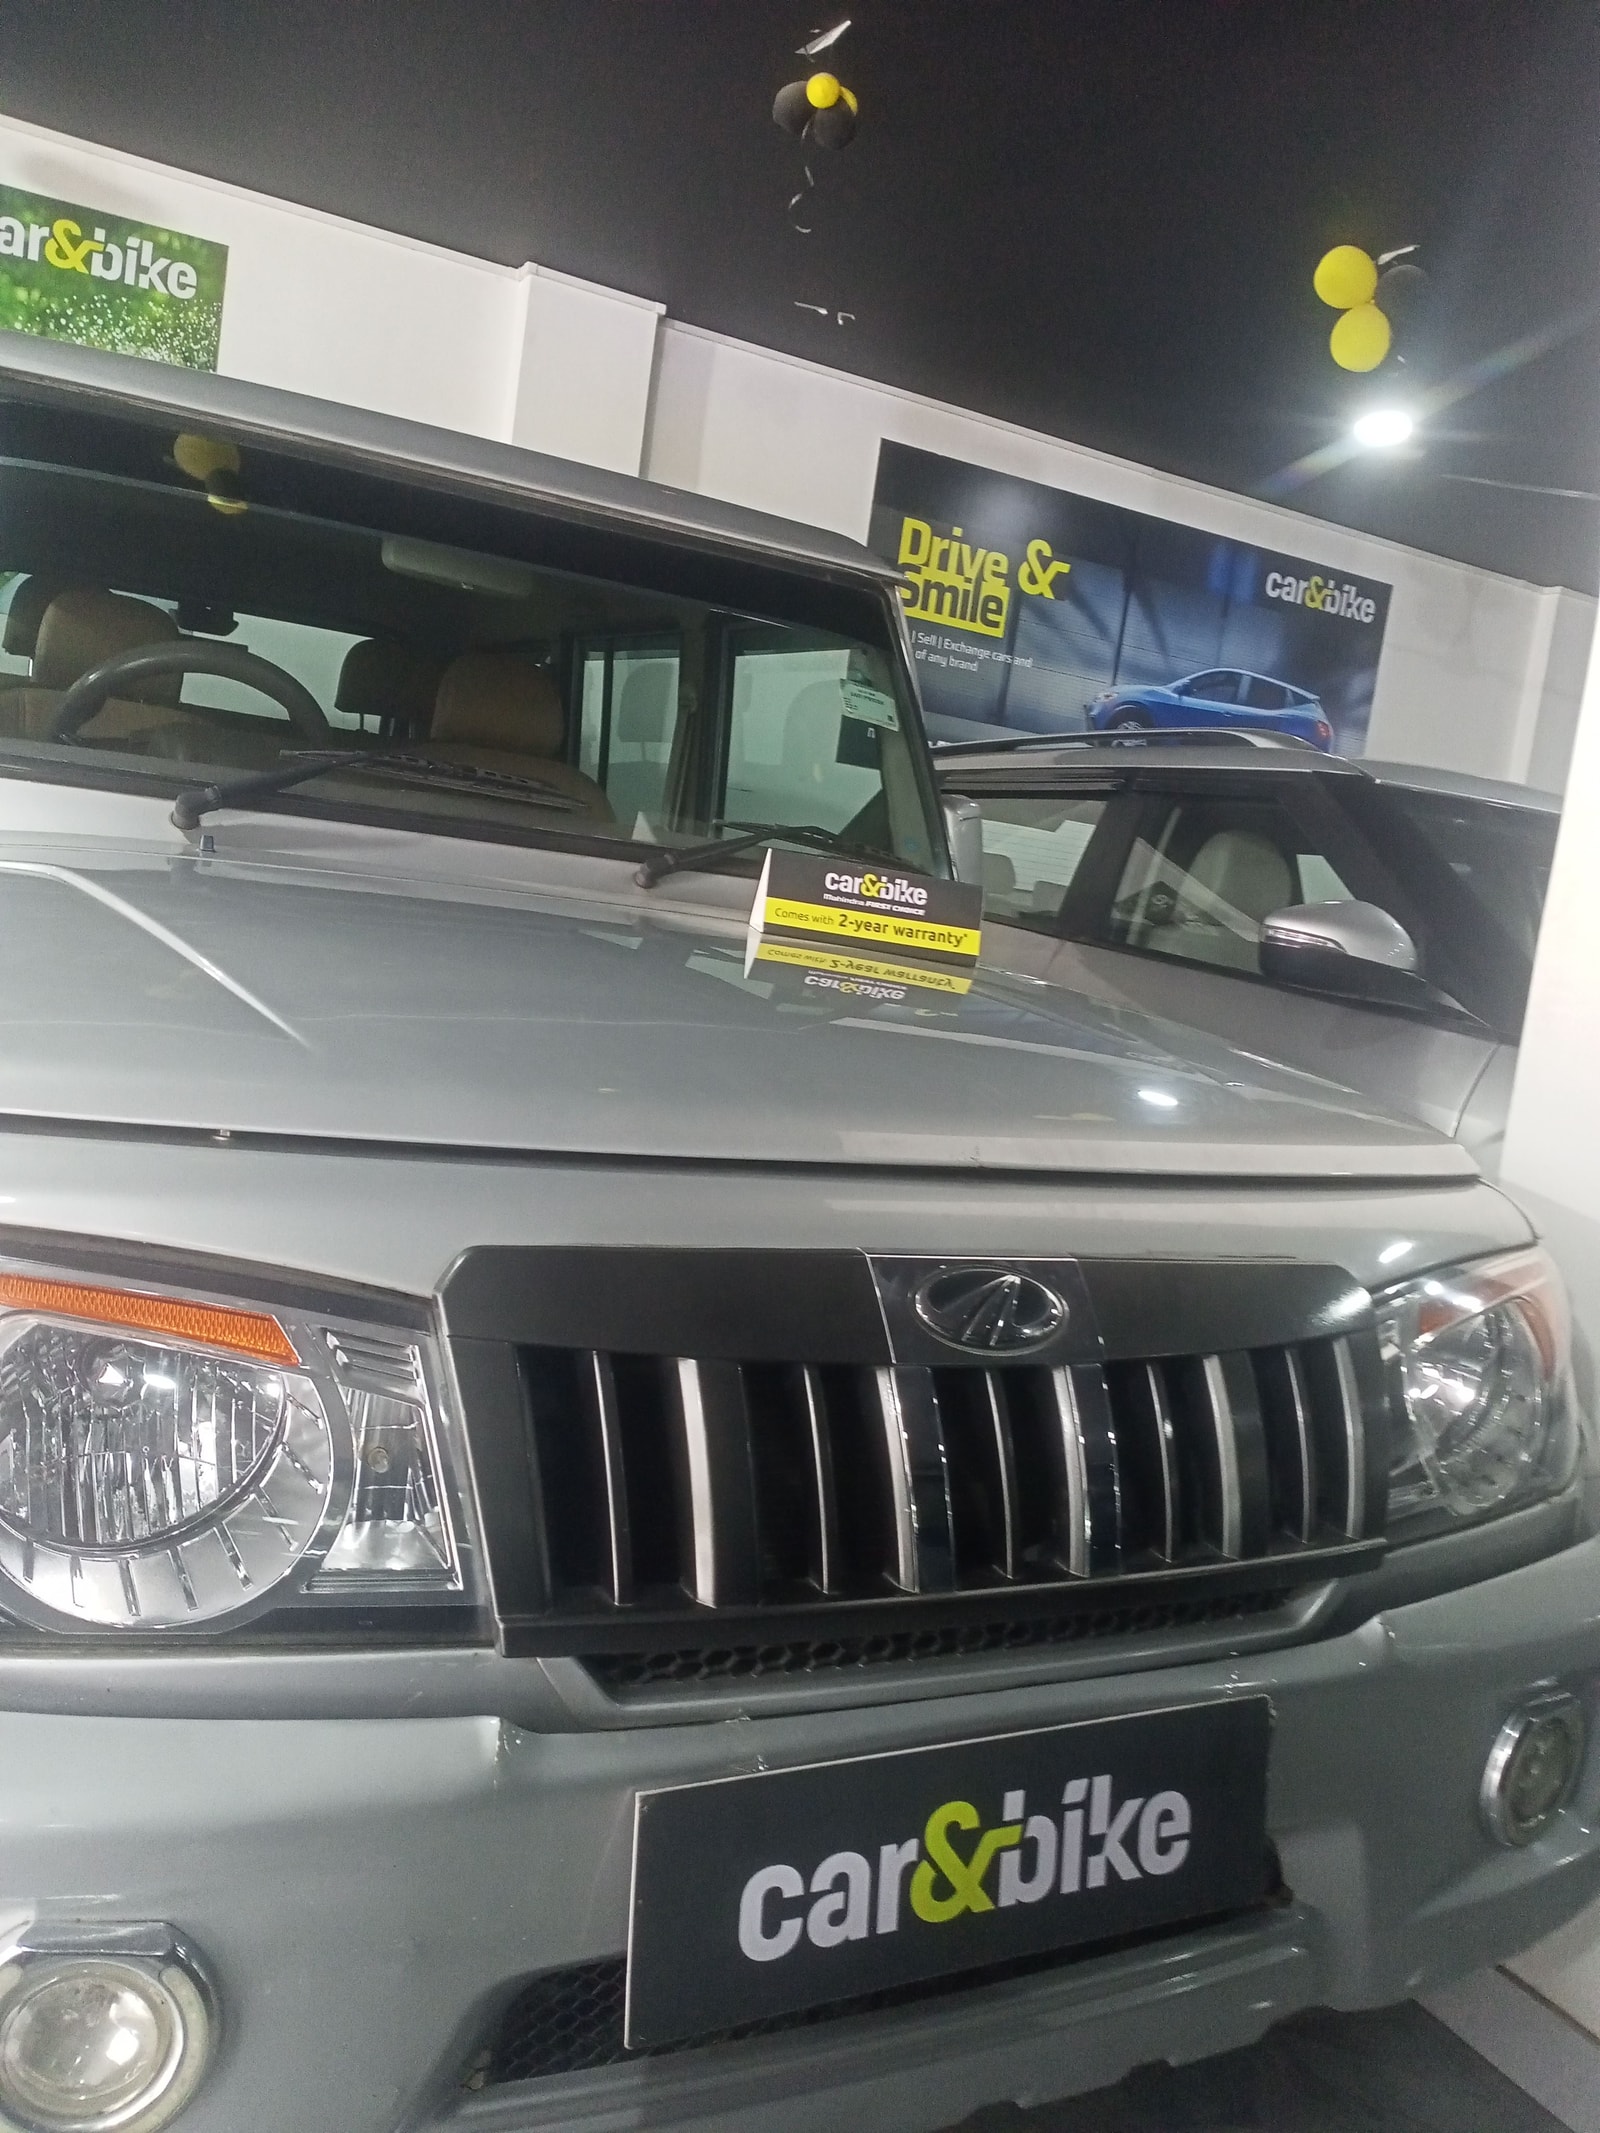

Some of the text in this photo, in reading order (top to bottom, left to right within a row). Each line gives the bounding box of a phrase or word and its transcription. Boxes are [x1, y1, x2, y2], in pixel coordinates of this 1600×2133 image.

[898, 517, 1071, 600] Drive &
[899, 562, 1004, 629] Smile
[1265, 572, 1376, 623] car&bike
[914, 649, 978, 672] of any brand
[917, 632, 938, 647] Sell
[943, 638, 992, 660] Exchange
[992, 651, 1013, 664] cars
[1013, 656, 1034, 668] and
[824, 872, 928, 906] car&bike
[774, 907, 809, 921] Comes
[811, 914, 835, 925] with
[838, 913, 889, 933] 2-year
[738, 1774, 1192, 1963] car&bike
